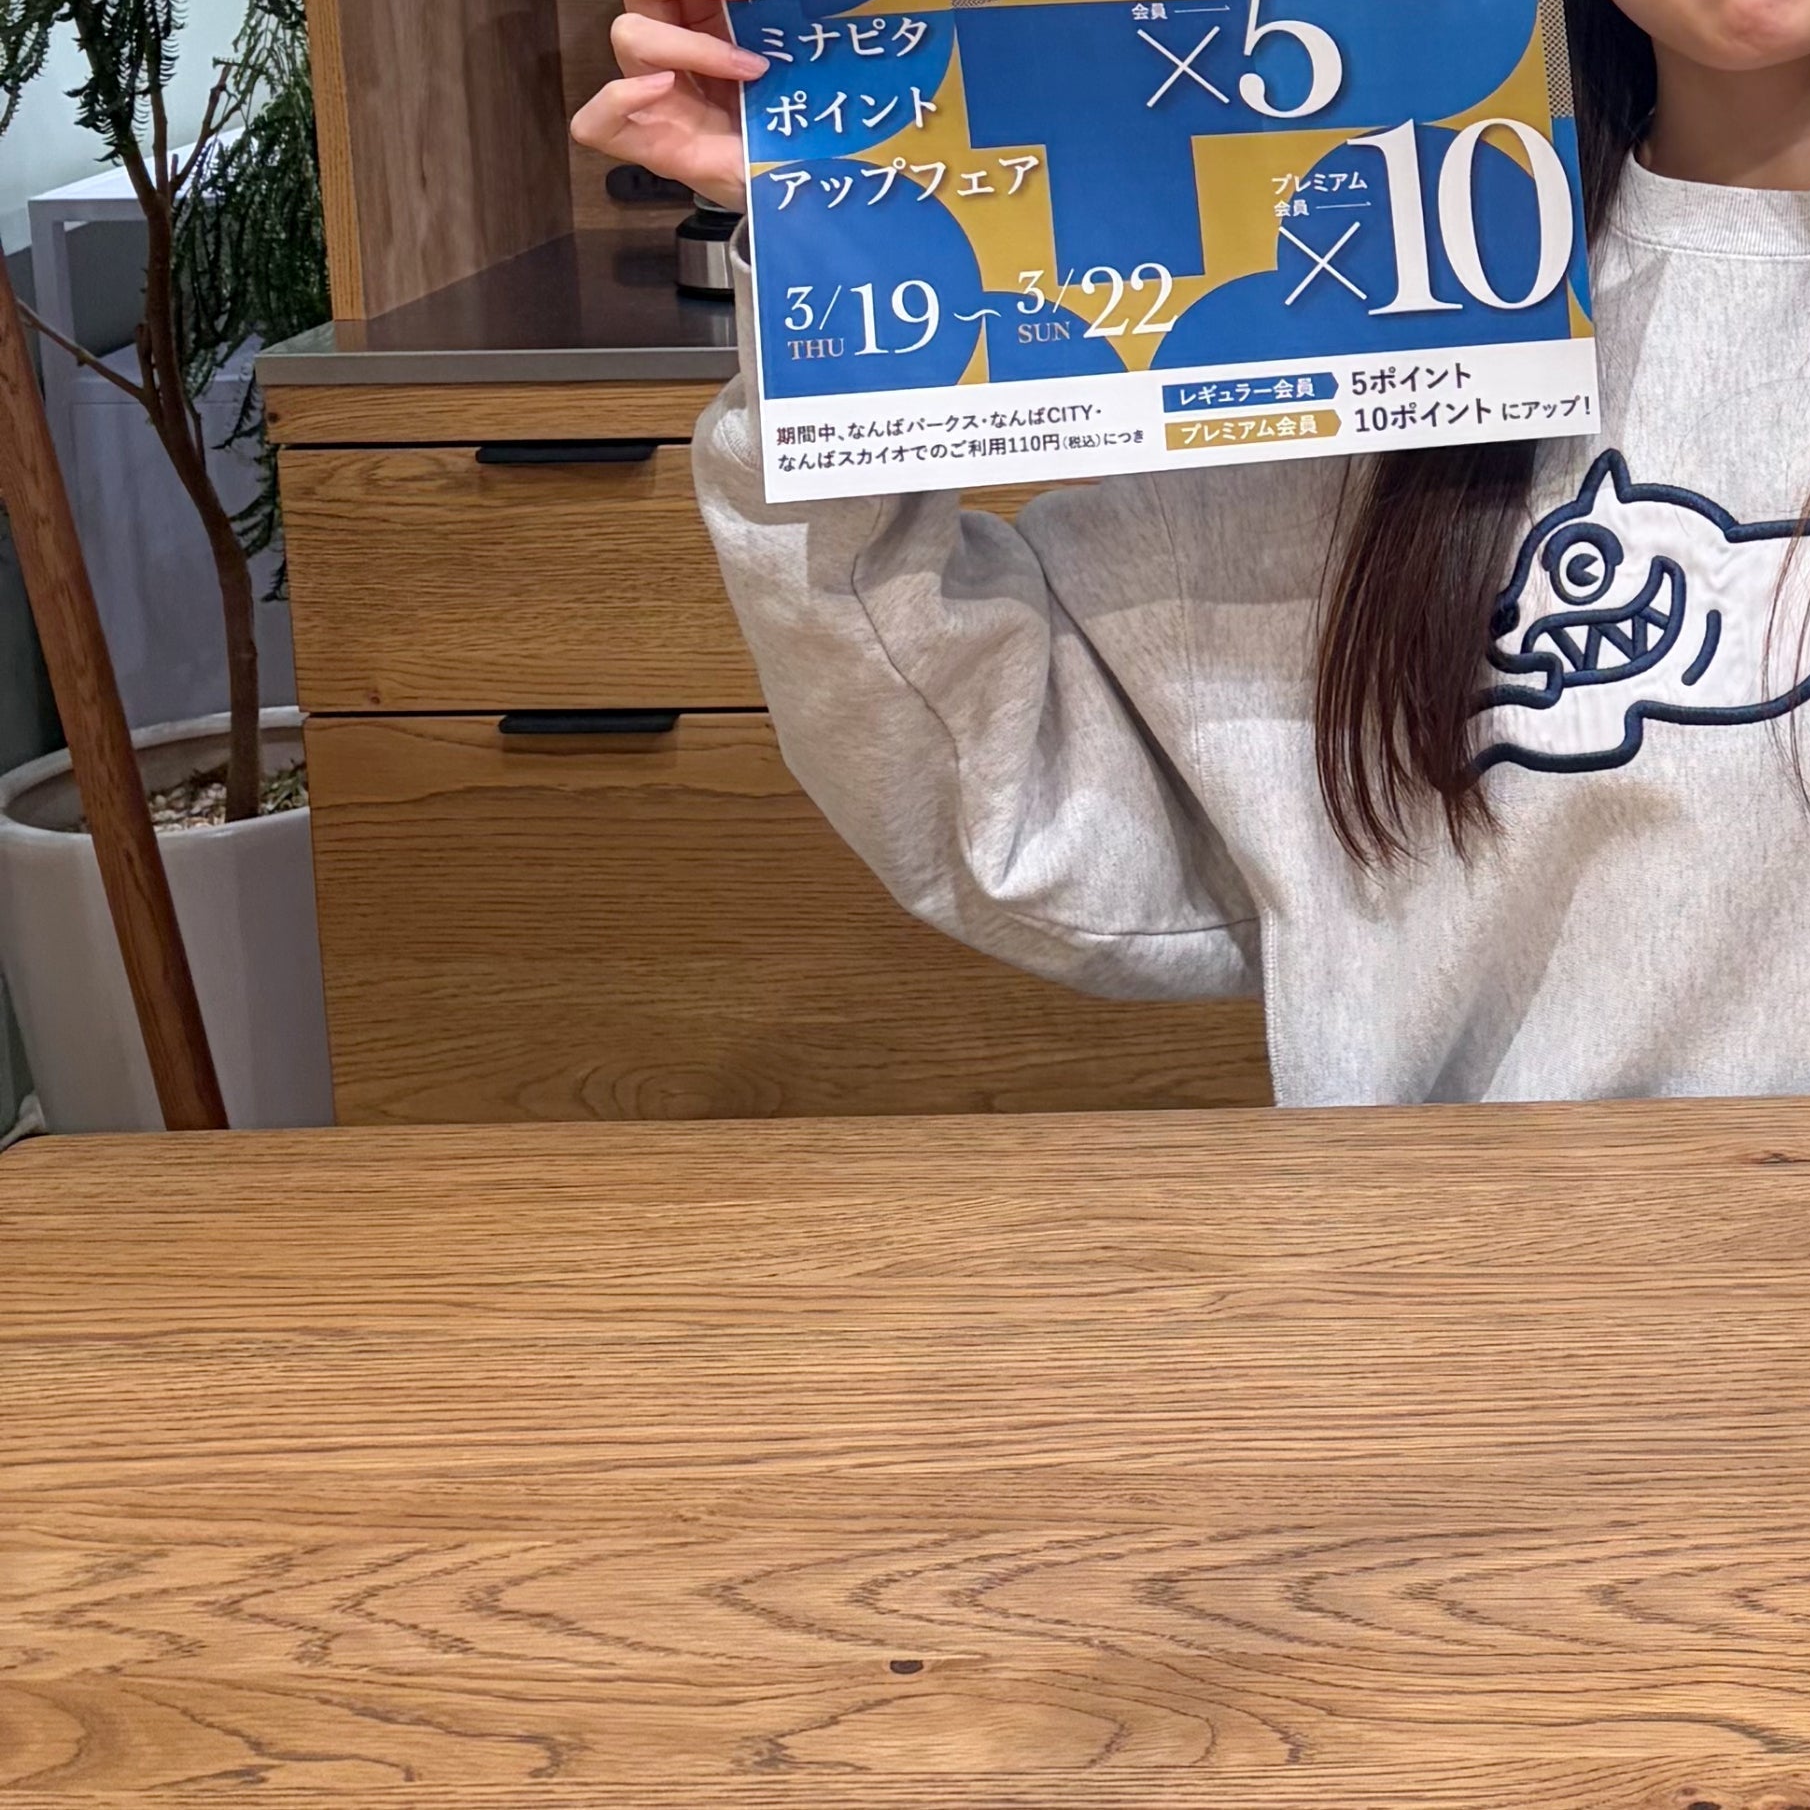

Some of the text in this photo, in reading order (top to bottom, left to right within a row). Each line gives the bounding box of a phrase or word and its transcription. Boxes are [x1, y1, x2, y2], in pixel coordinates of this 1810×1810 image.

[1131, 2, 1168, 21] 会員
[761, 16, 928, 63] ミナピタ
[765, 85, 938, 137] ポイント
[769, 155, 1040, 211] アップフェア
[1271, 171, 1368, 195] プレミアム
[1273, 199, 1310, 218] 会員
[787, 320, 1071, 361] THU SUN
[1179, 361, 1472, 407] レギュラー会員 5ポイント
[1181, 395, 1591, 446] プレミアム会員 10ポイント にアップ!
